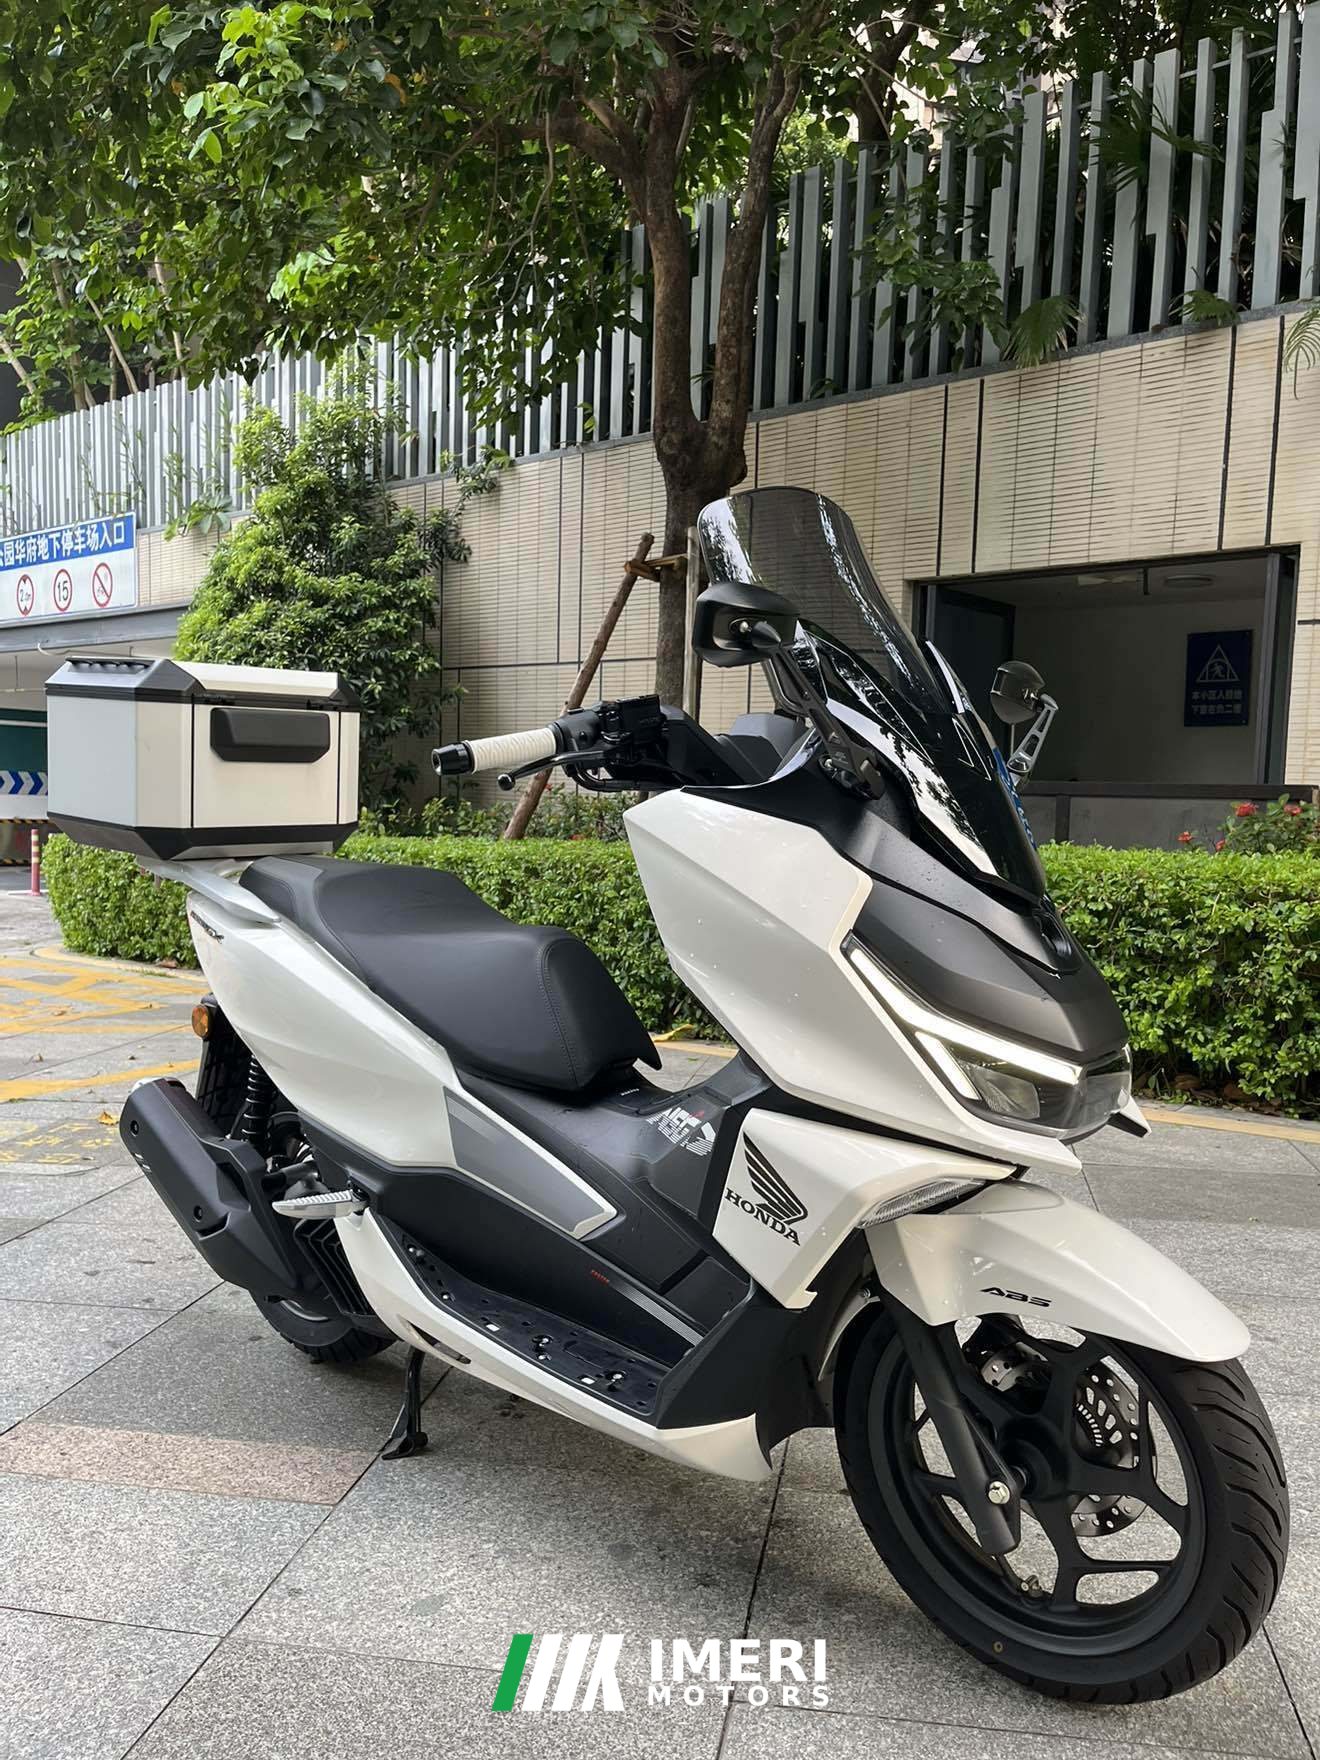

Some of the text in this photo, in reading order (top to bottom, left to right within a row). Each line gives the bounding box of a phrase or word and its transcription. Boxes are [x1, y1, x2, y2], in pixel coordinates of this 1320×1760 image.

[57, 580, 69, 602] 15
[724, 1187, 801, 1247] HONDA
[980, 1287, 1052, 1307] ABS
